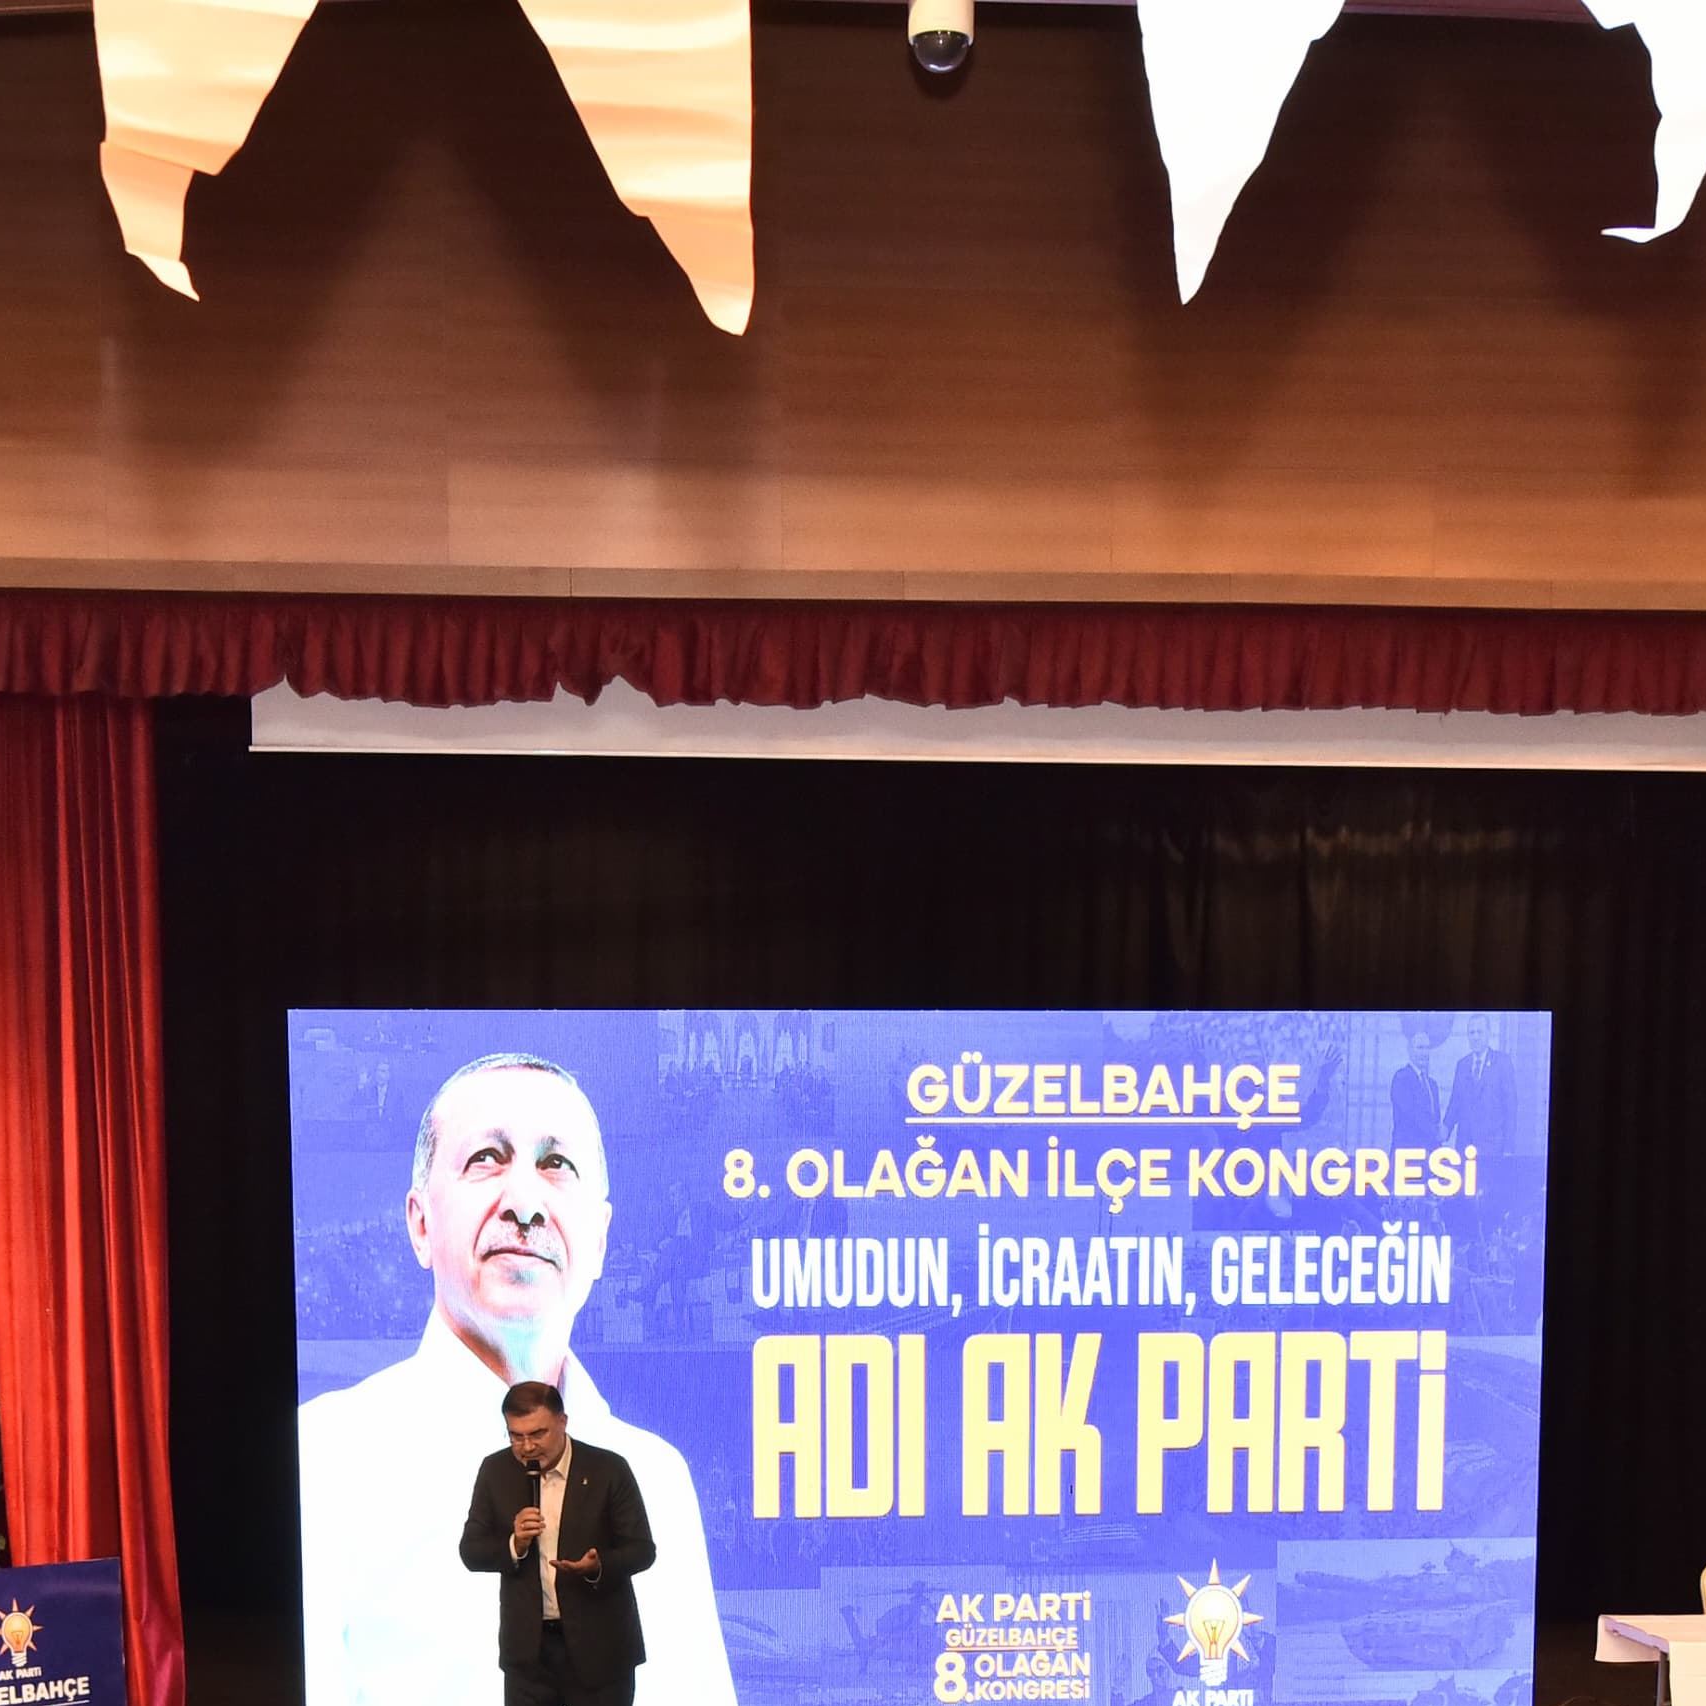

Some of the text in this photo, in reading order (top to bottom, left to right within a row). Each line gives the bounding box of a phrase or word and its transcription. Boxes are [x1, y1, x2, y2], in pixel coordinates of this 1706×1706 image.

[906, 1054, 1301, 1130] GÜZELBAHÇE
[722, 1149, 770, 1199] 8.
[787, 1136, 1030, 1198] OLAĞAN
[1046, 1136, 1170, 1214] İLÇE
[750, 1220, 1452, 1318] UMUDUN, İCRAATIN, GELECEĞİN
[752, 1333, 926, 1518] ADI
[961, 1333, 1103, 1516] AK
[936, 1594, 984, 1622] AK
[945, 1624, 1079, 1651] GÜZELBAHÇE
[933, 1649, 1091, 1703] 8. OLAĞAN
